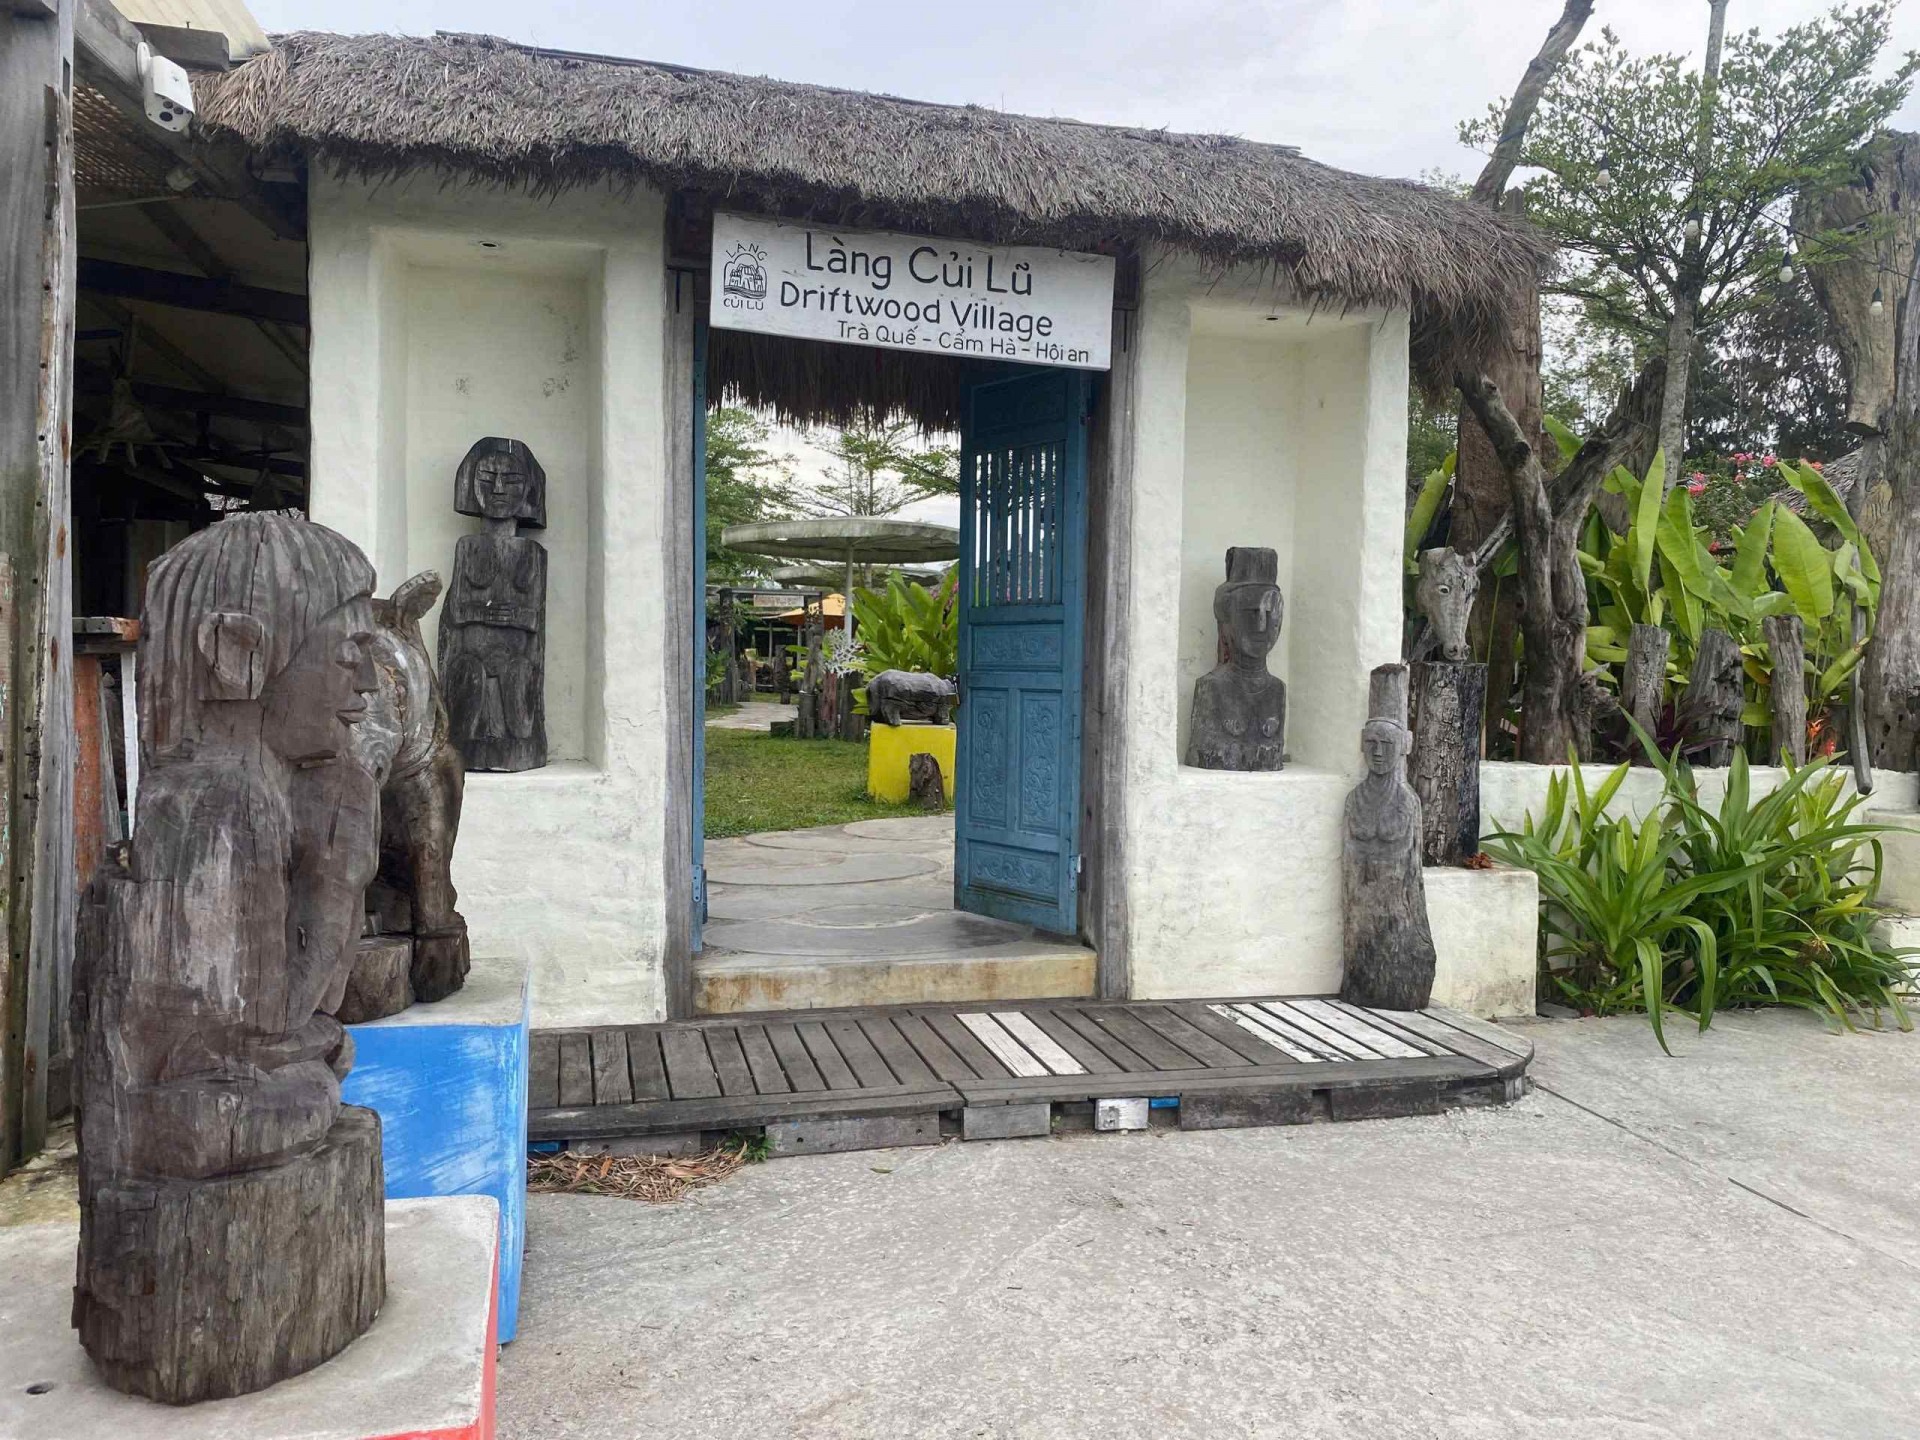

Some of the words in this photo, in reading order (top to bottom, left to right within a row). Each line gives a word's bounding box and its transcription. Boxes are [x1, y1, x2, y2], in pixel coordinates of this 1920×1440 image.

[806, 232, 891, 290] Làng
[909, 246, 972, 288] Củi
[987, 255, 1032, 296] Lũ
[780, 281, 940, 324] Driftwood
[950, 300, 1053, 342] Village
[837, 320, 869, 340] Trà
[876, 325, 919, 345] Quế
[939, 328, 983, 351] Cẩm
[991, 337, 1016, 355] Hà
